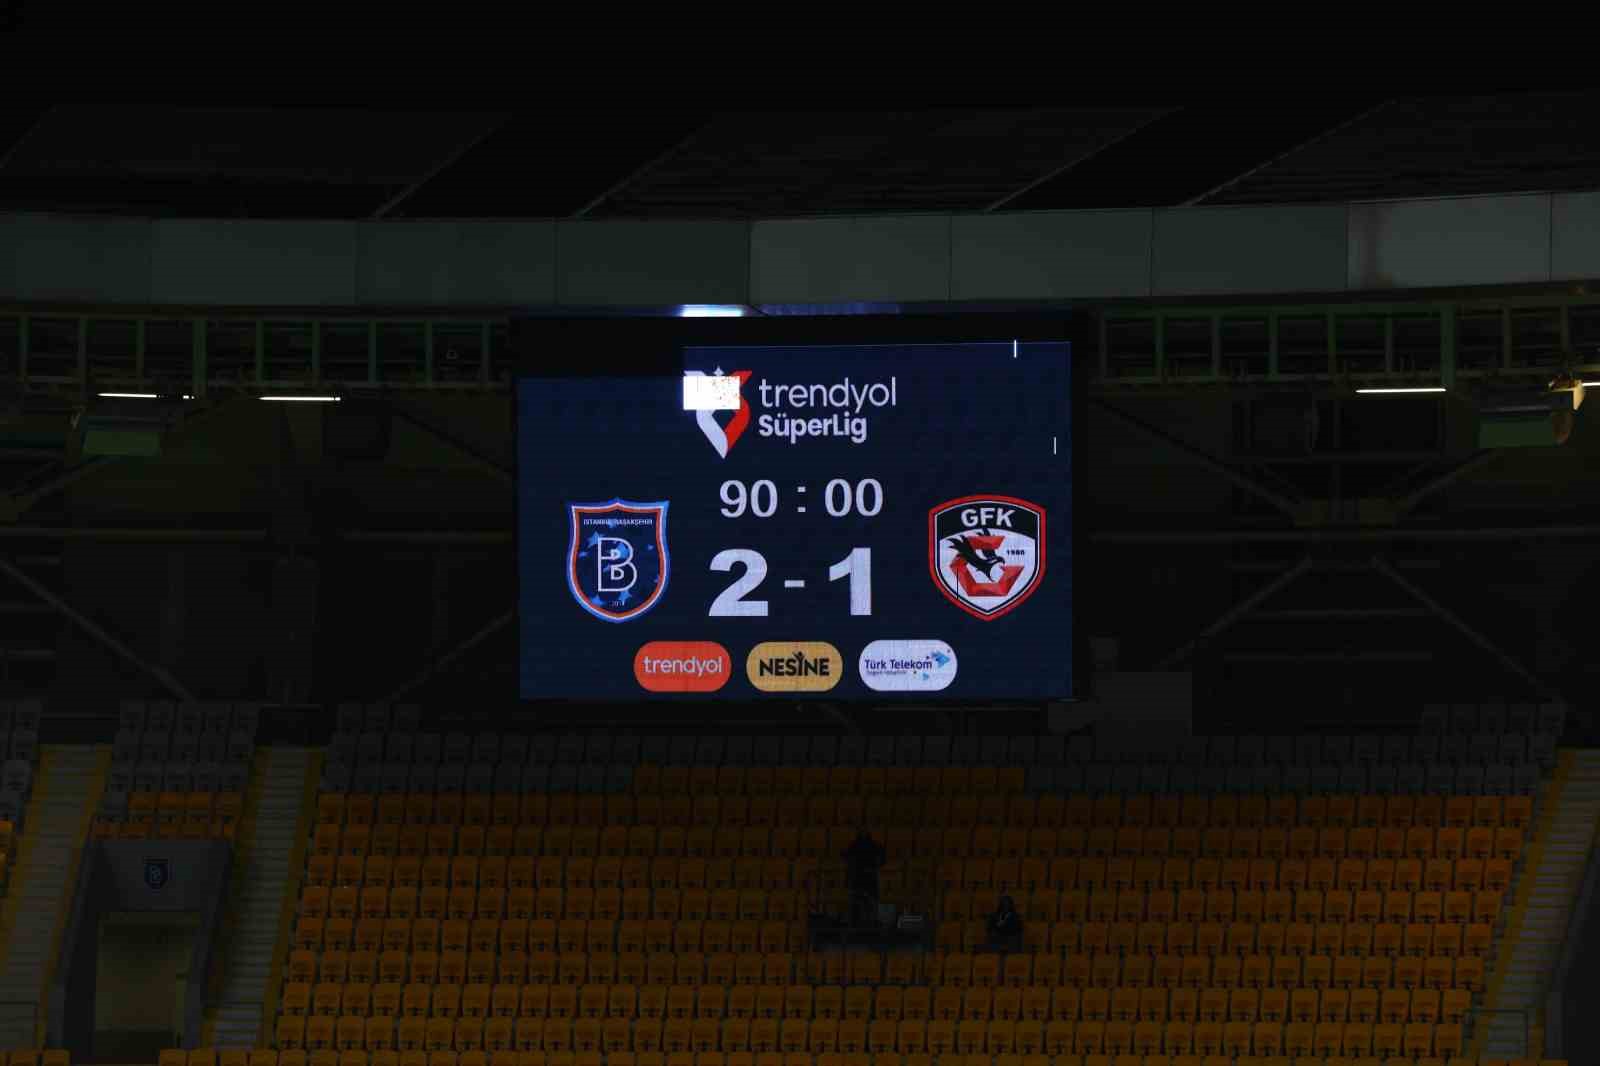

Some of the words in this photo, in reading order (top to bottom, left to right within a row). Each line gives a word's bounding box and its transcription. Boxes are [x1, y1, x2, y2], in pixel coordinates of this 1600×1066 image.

[759, 376, 896, 413] trendyol
[758, 412, 867, 444] SüperLig
[719, 479, 778, 518] 90
[824, 478, 883, 517] 00
[960, 507, 1016, 527] GFK
[708, 548, 769, 617] 2
[828, 547, 872, 616] 1
[643, 656, 723, 677] trendyol
[864, 658, 887, 670] Türk
[889, 658, 933, 670] Telekom
